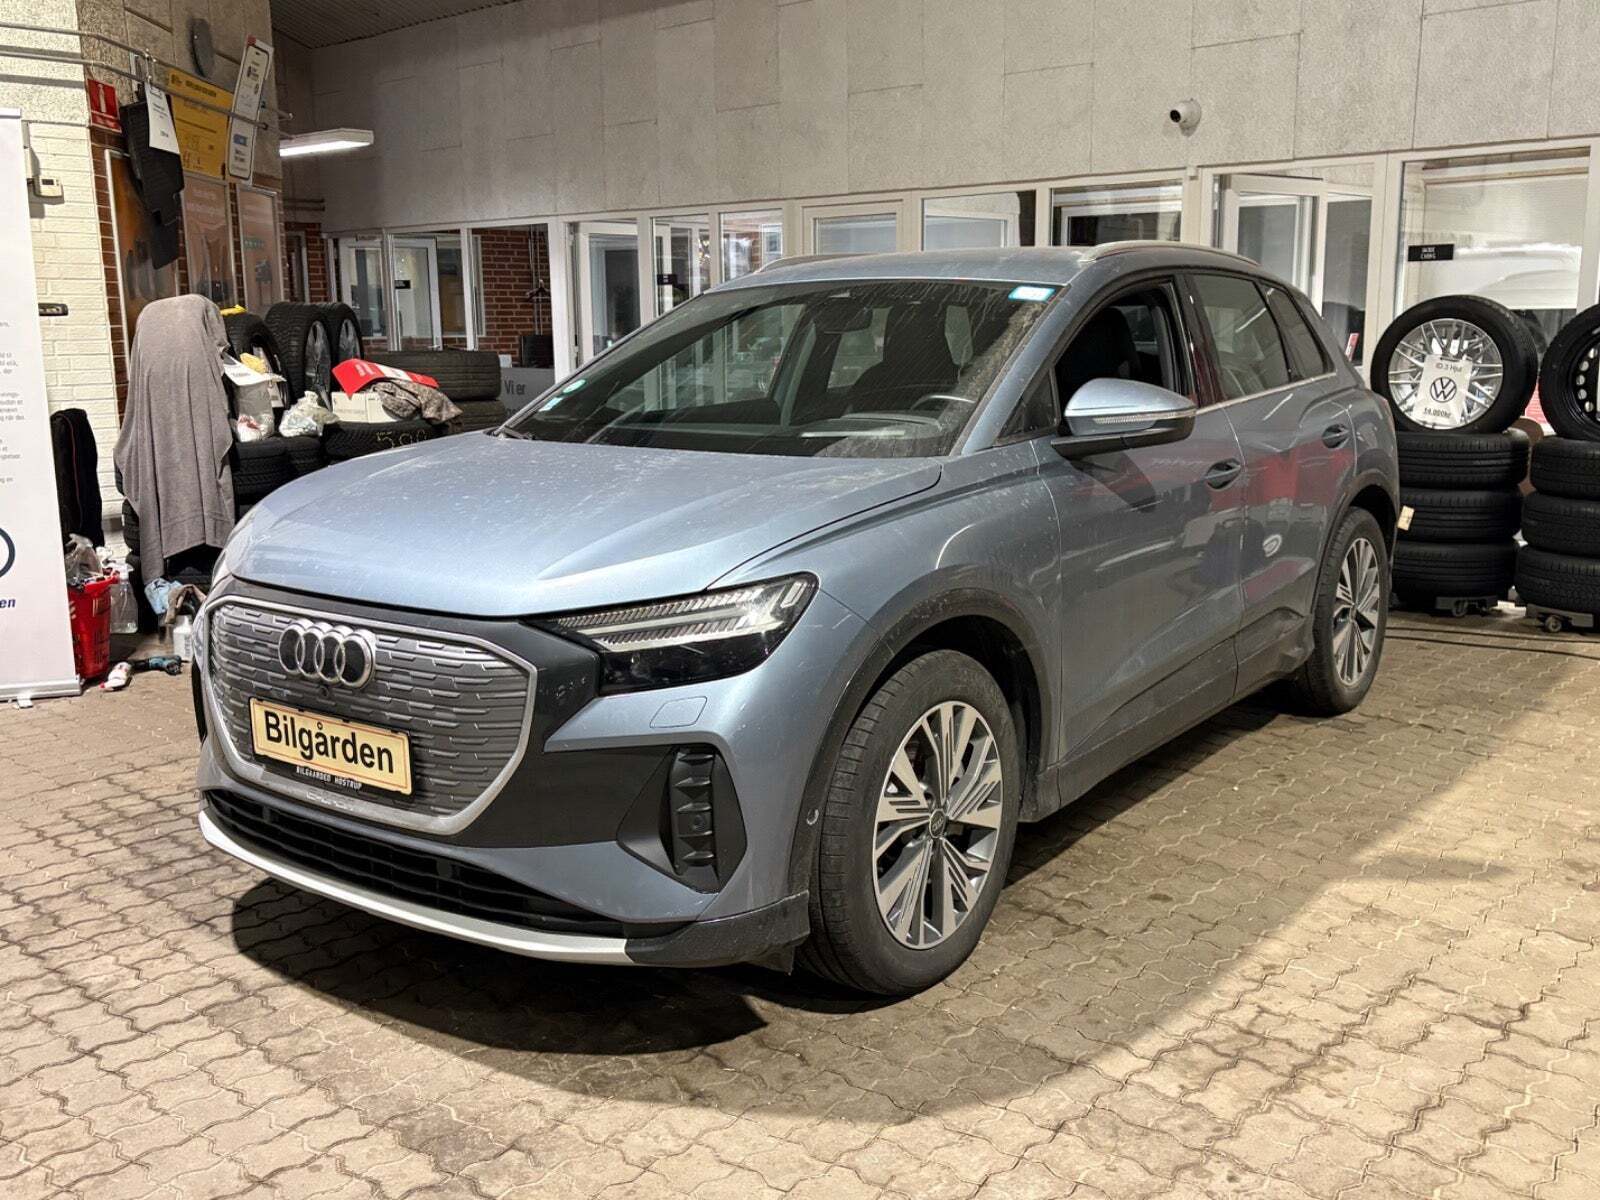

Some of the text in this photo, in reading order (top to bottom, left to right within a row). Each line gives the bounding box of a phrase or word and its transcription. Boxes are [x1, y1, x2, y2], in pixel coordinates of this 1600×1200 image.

[504, 380, 526, 396] Vi er
[263, 710, 394, 774] Bilgården
